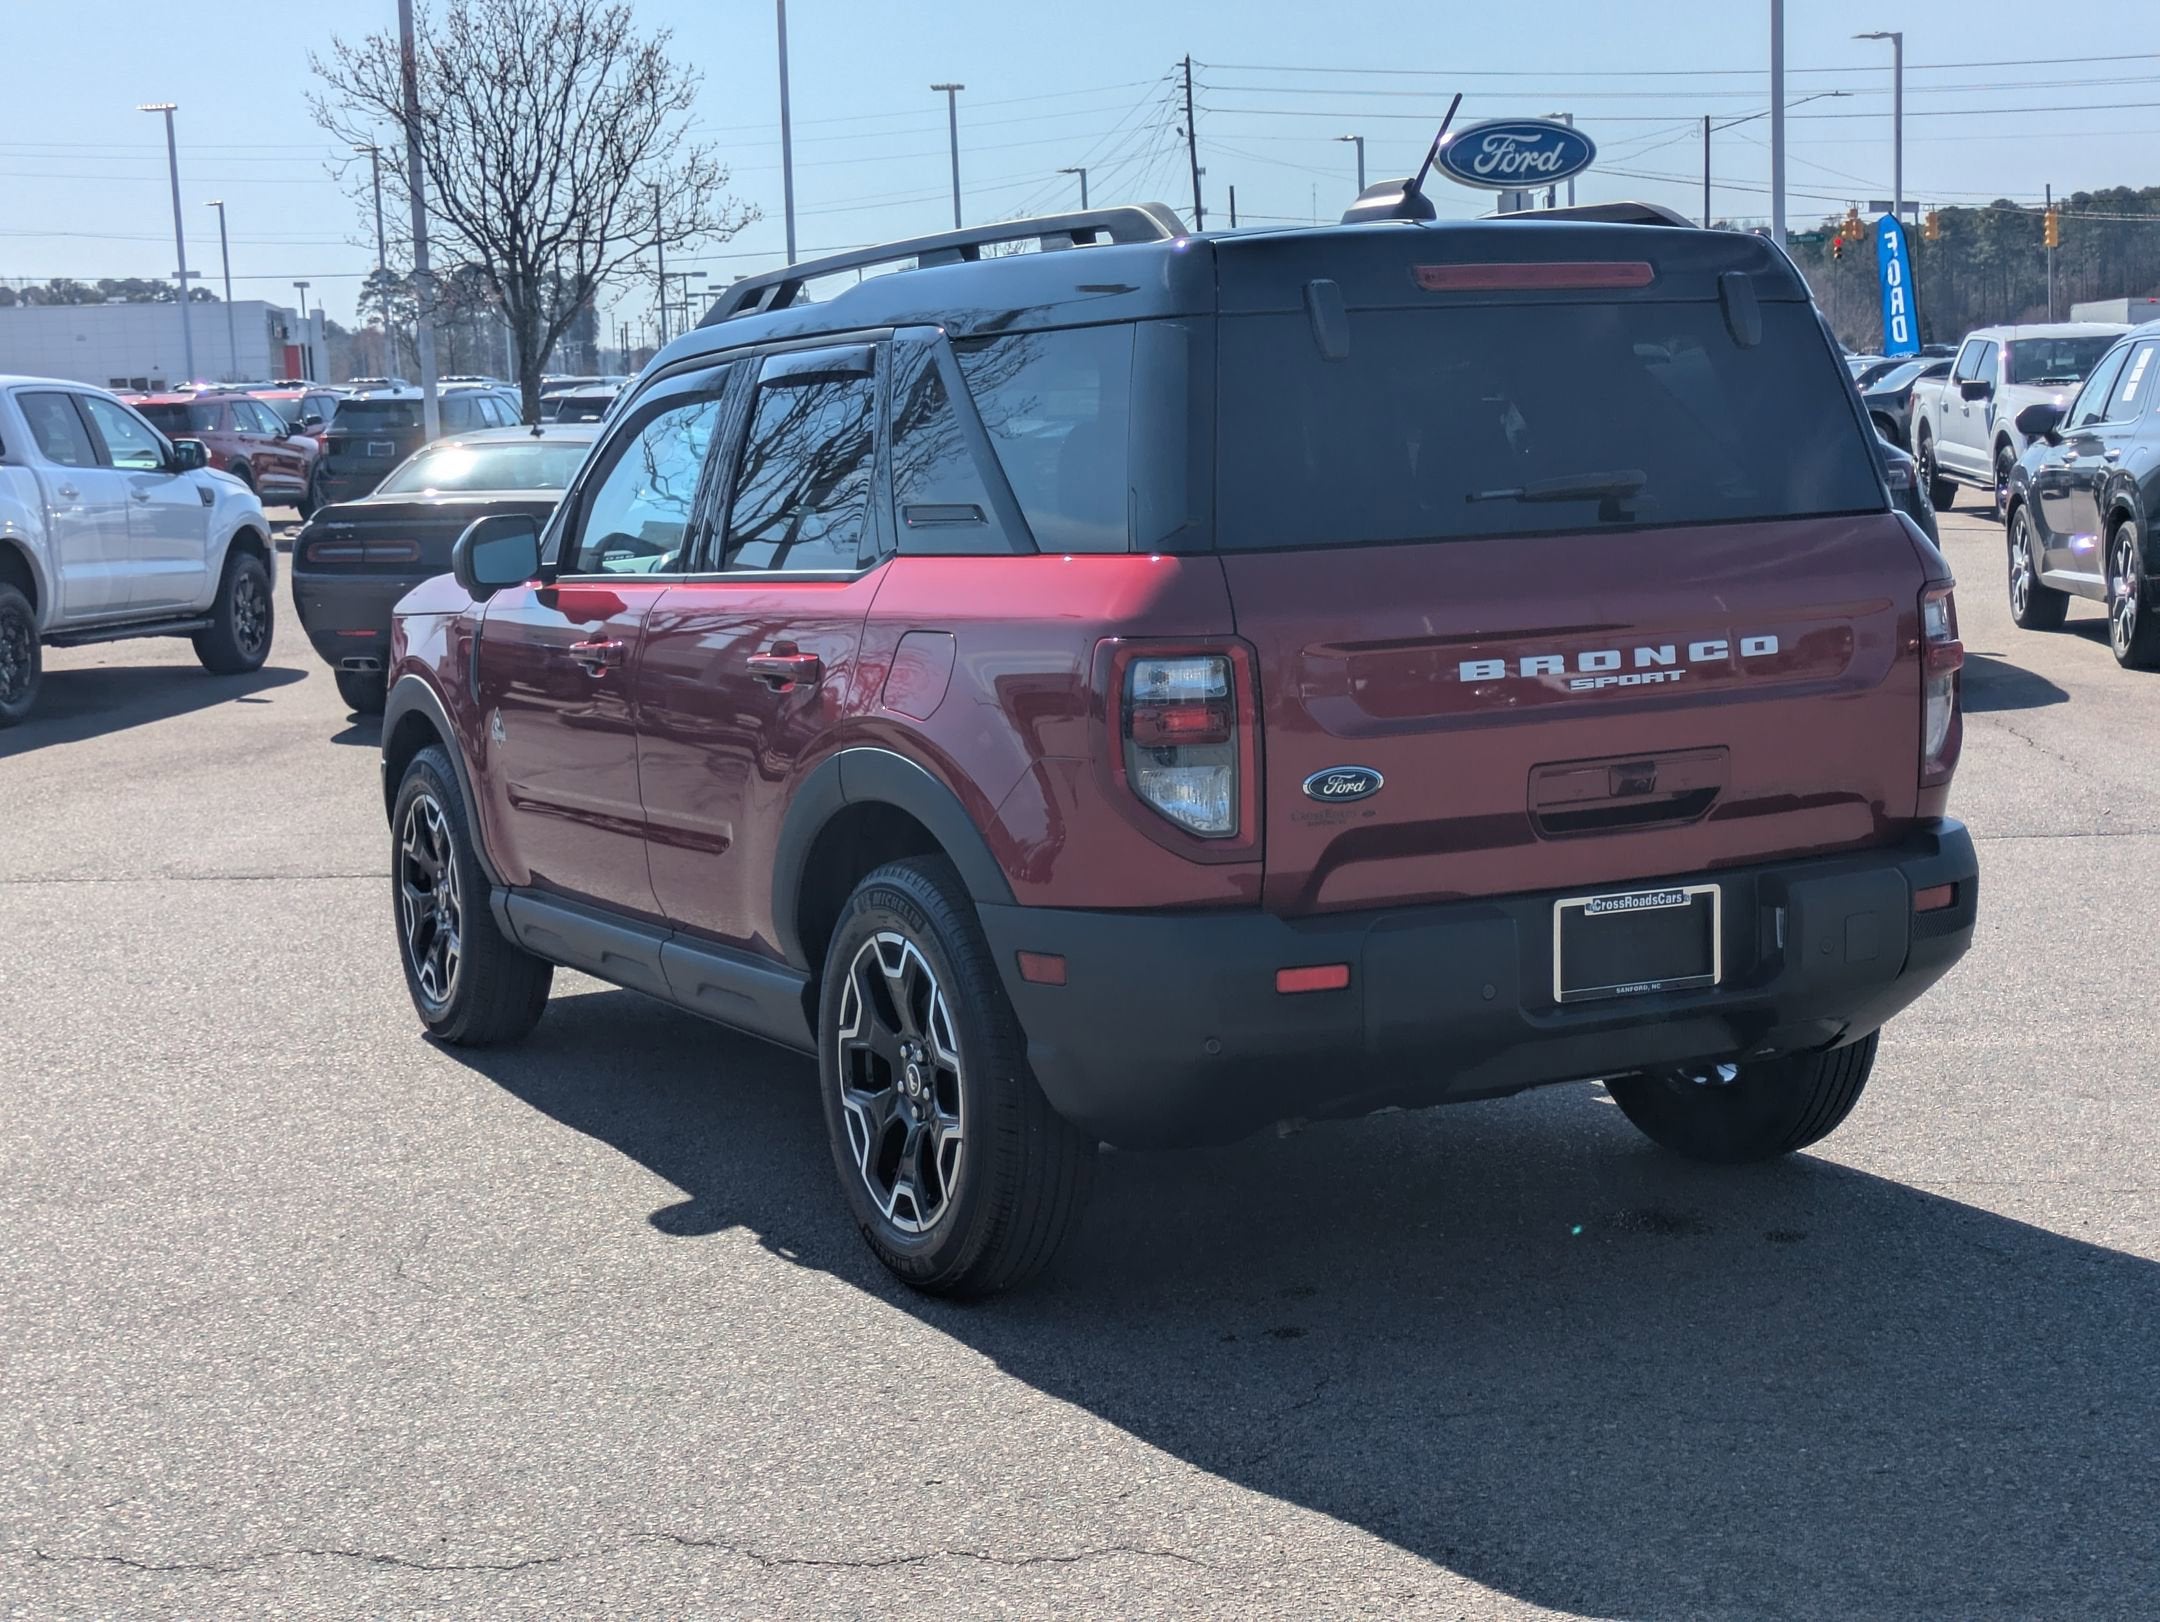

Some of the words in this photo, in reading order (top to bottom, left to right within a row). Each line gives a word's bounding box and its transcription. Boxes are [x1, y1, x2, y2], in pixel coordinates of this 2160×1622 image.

[1474, 133, 1566, 174] Ford
[1459, 635, 1778, 682] BRONCO
[1570, 670, 1686, 690] SPORT
[1323, 774, 1367, 794] Ford
[872, 891, 923, 932] MICHELIN
[1594, 892, 1682, 911] CrossRoadsCars
